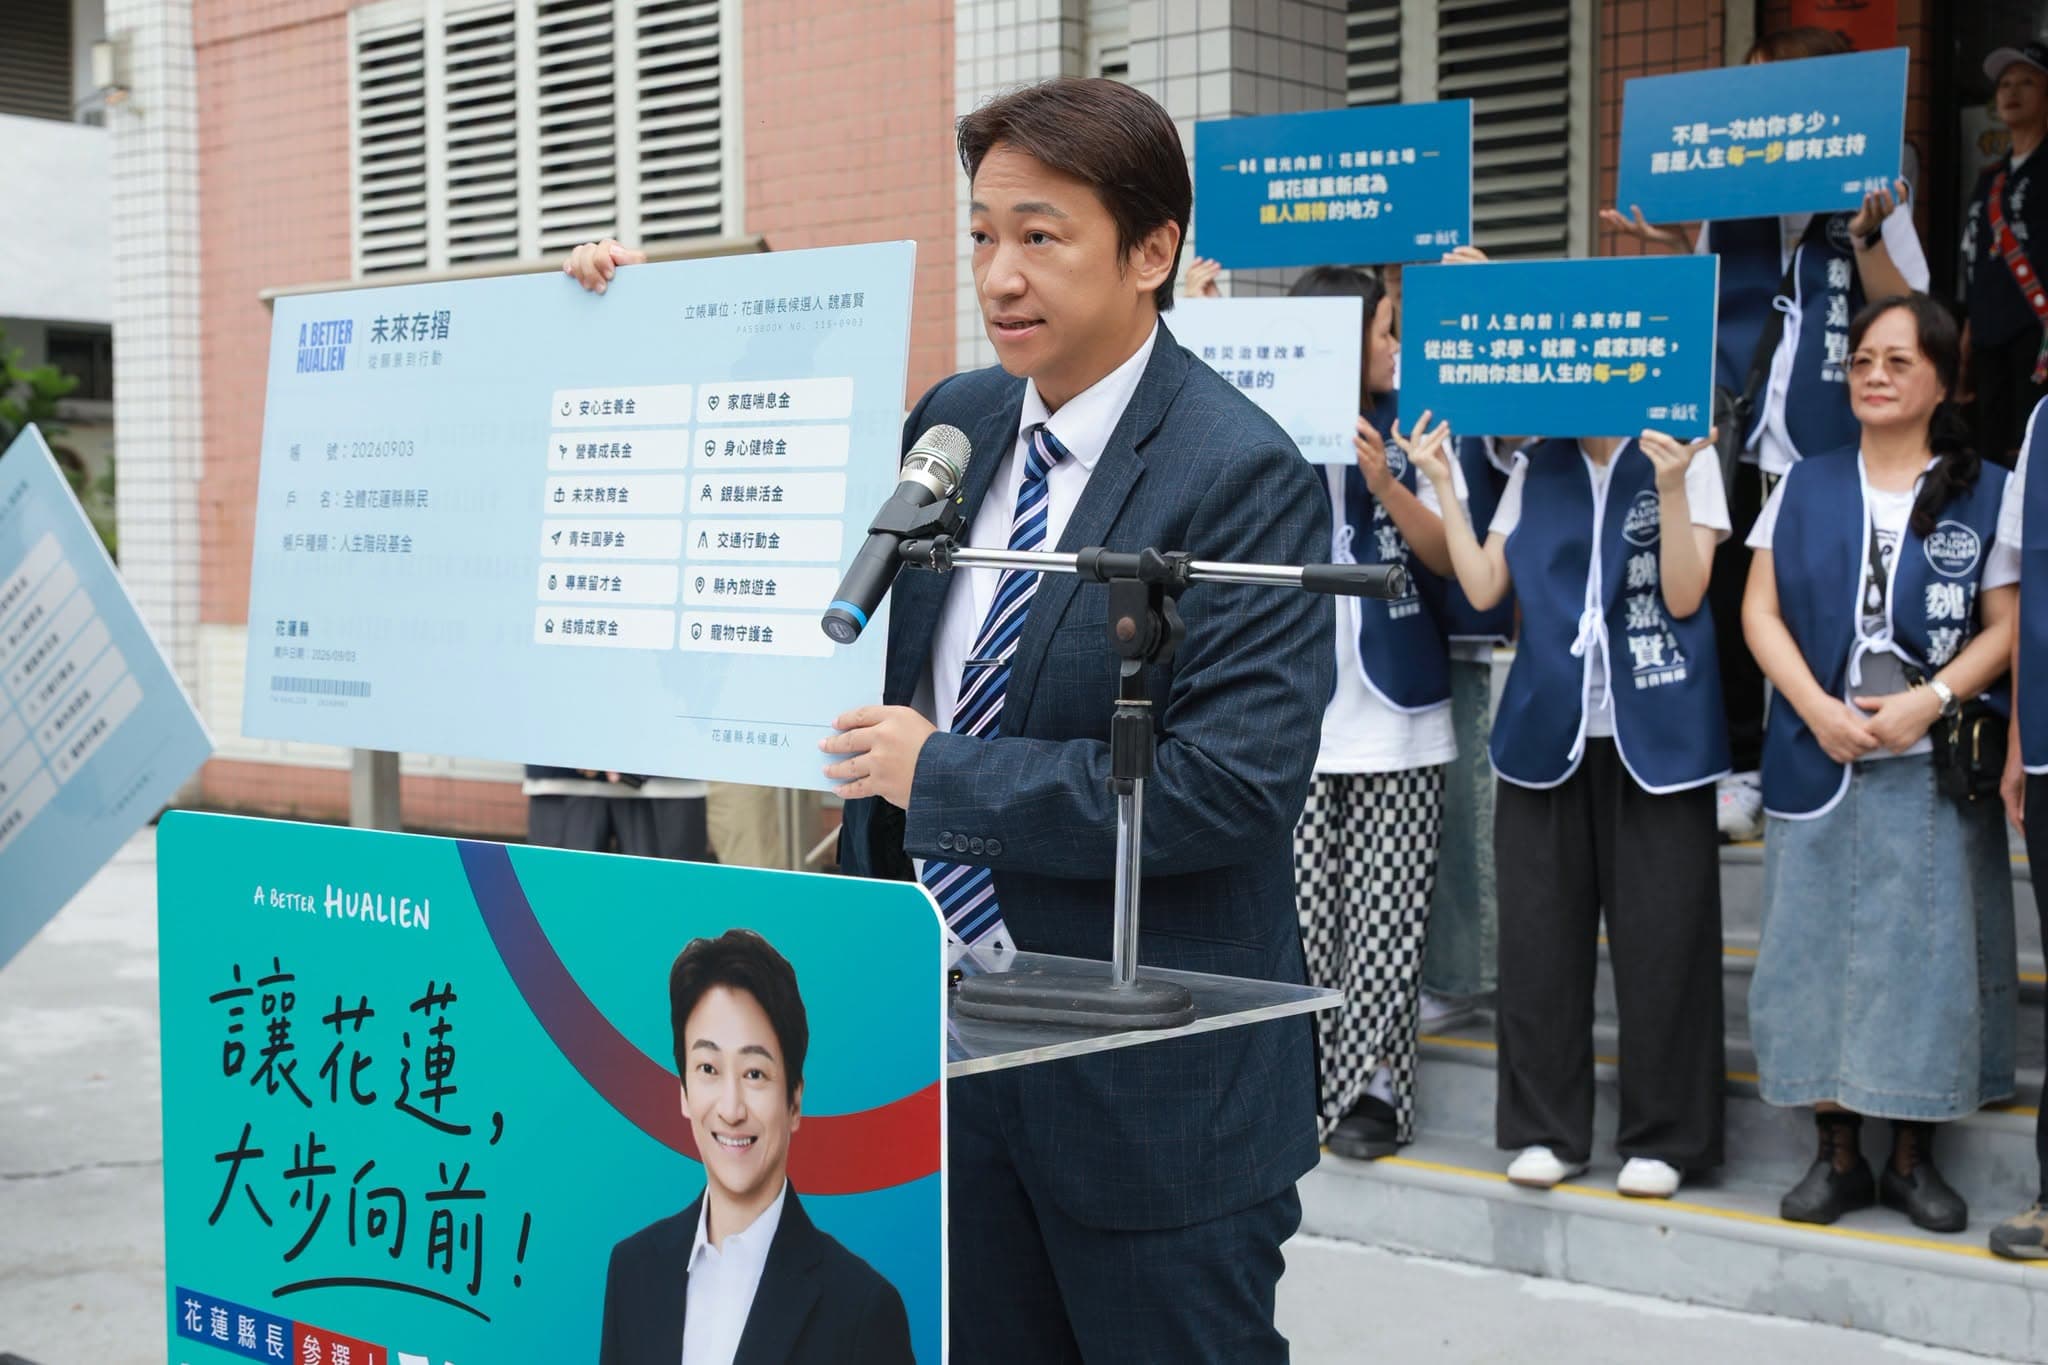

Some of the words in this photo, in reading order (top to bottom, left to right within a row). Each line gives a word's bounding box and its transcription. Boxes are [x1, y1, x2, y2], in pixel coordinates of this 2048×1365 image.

[299, 323, 308, 346] A
[311, 319, 353, 346] BETTER
[370, 310, 451, 344] 未來存摺
[296, 346, 346, 374] HUALIEN
[579, 398, 636, 416] 安心生養金
[727, 392, 791, 410] 家庭喘息金
[575, 442, 633, 460] 營養成長金
[724, 439, 787, 457] 身心健檢金
[571, 487, 629, 503] 未來教育金
[720, 485, 784, 503] 銀髮樂活金
[568, 531, 626, 548] 青年圓夢金
[717, 532, 781, 549] 交通行動金
[564, 575, 622, 592] 專業留才金
[713, 578, 777, 596] 縣內旅遊金
[561, 619, 618, 637] 結婚成家金
[710, 624, 774, 643] 寵物守護金
[254, 885, 265, 906] A
[270, 888, 317, 914] BETTER
[323, 884, 430, 930] HUALIEN
